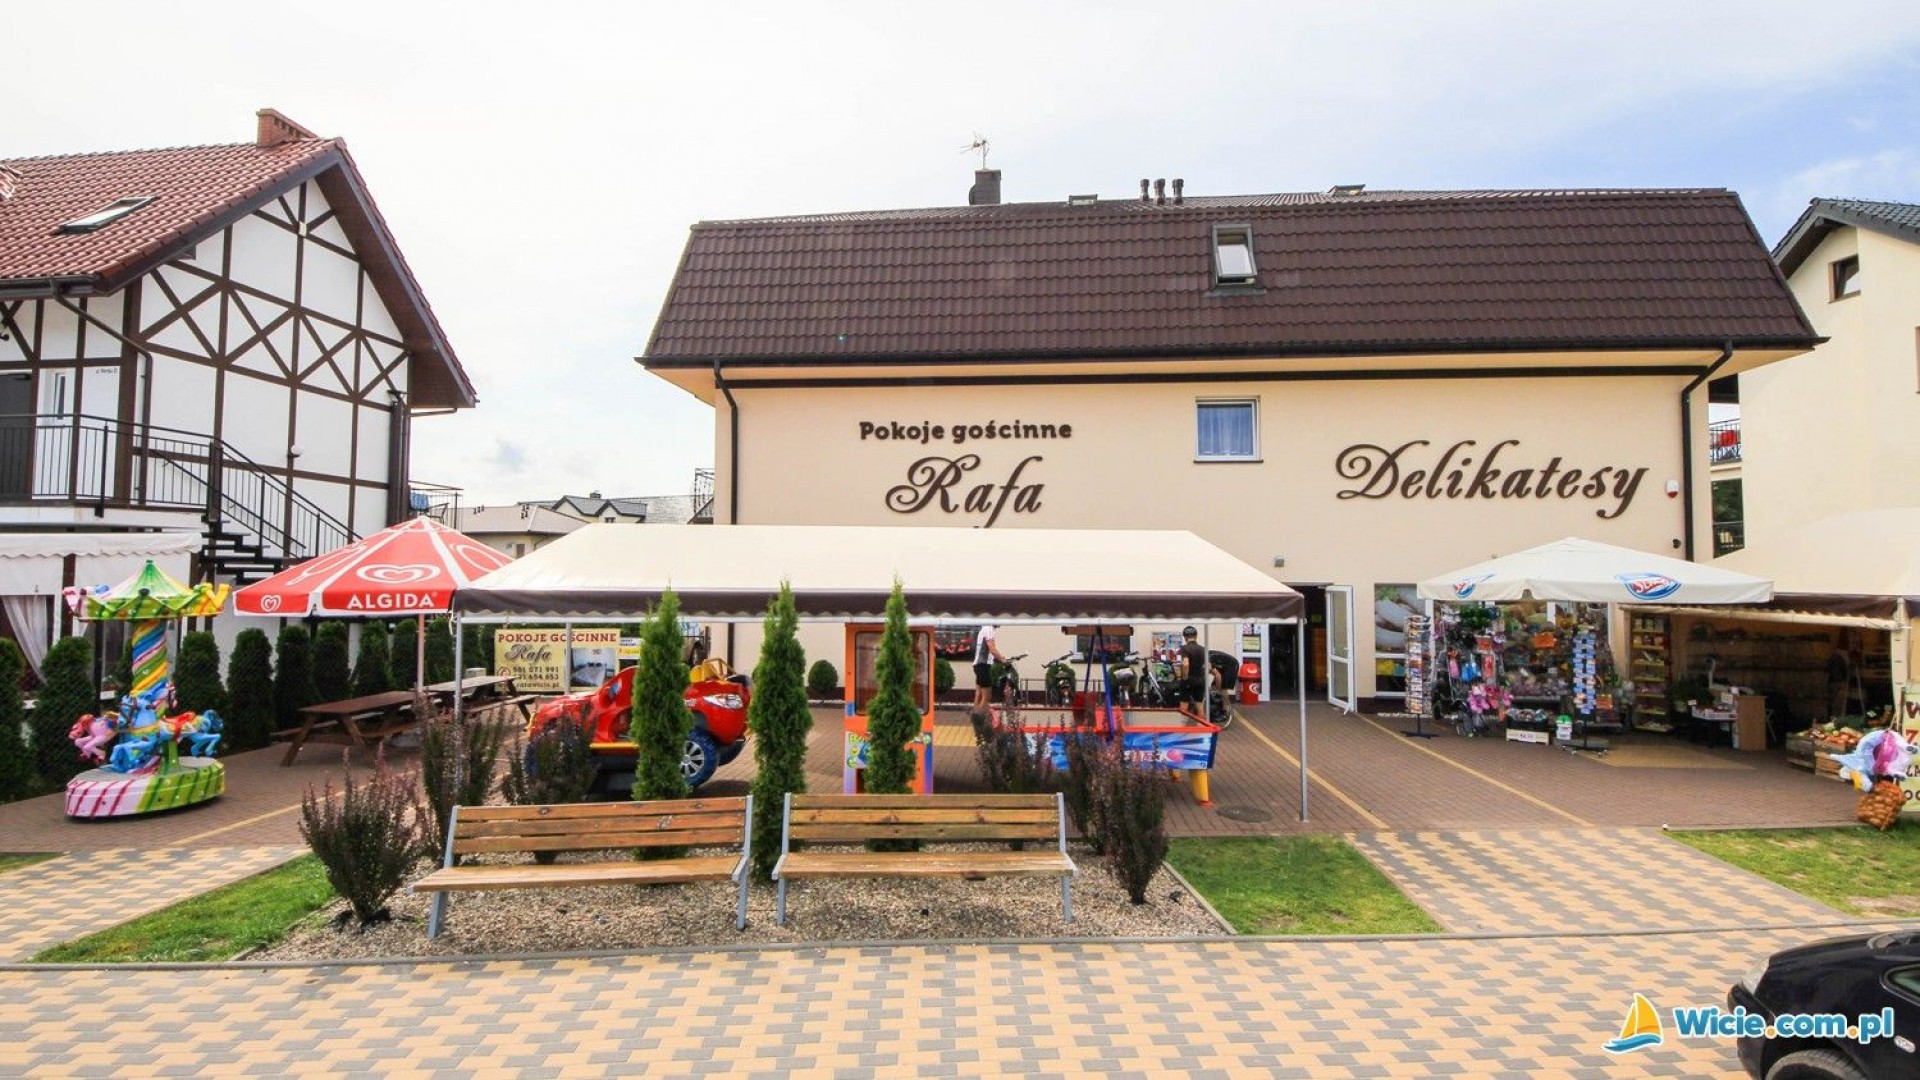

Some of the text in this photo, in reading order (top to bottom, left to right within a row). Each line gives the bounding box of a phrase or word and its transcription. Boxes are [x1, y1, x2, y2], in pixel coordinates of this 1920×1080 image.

[859, 419, 1072, 444] Pokoje gościnne
[1335, 439, 1650, 519] Delikatesy
[885, 453, 1045, 529] Rafa
[347, 593, 435, 609] ALGIDA
[498, 632, 547, 643] POKOJE
[504, 643, 552, 664] Rafa
